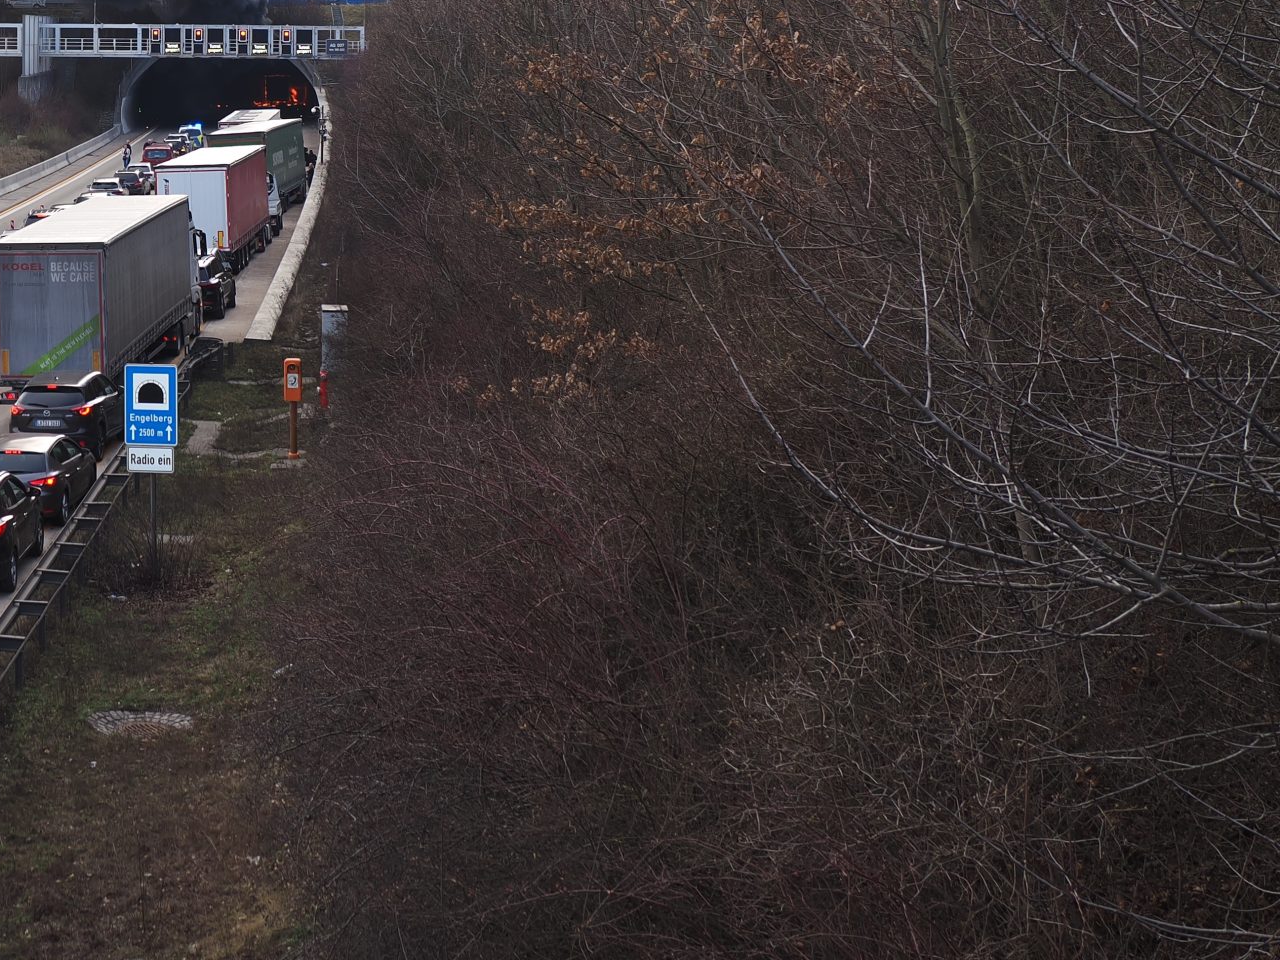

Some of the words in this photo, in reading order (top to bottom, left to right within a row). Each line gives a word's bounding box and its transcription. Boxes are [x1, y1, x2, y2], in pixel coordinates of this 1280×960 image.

[50, 262, 95, 272] BECAUSE
[50, 272, 68, 282] WE
[70, 272, 95, 282] CARE
[65, 340, 76, 351] NEW
[129, 413, 173, 425] Engelberg
[138, 428, 155, 437] 2500
[130, 453, 155, 465] Radio
[157, 454, 171, 466] ein
